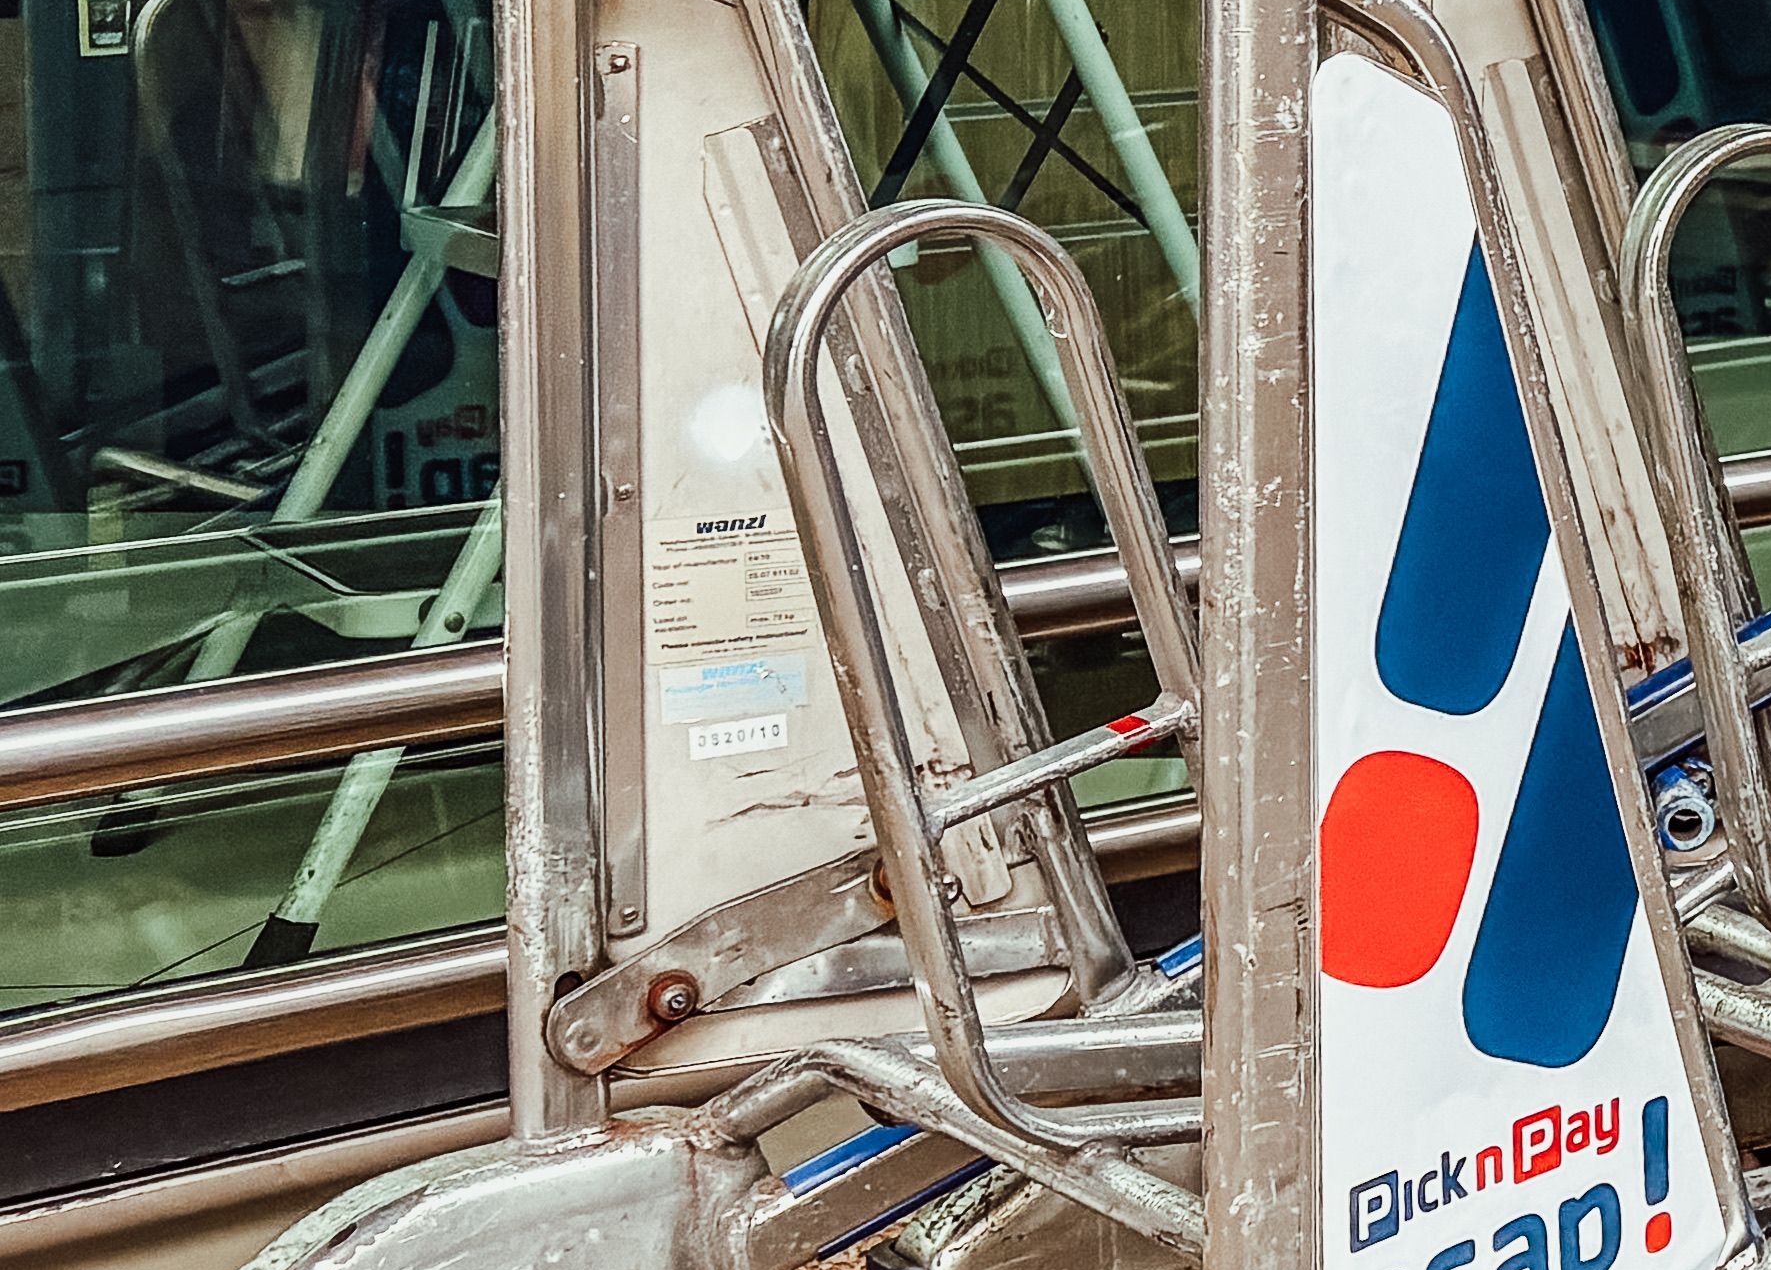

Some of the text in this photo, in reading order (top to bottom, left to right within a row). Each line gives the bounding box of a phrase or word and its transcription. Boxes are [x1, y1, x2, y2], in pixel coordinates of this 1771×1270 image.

[696, 514, 767, 535] wanzl
[1348, 1096, 1621, 1254] Pick n Pay
